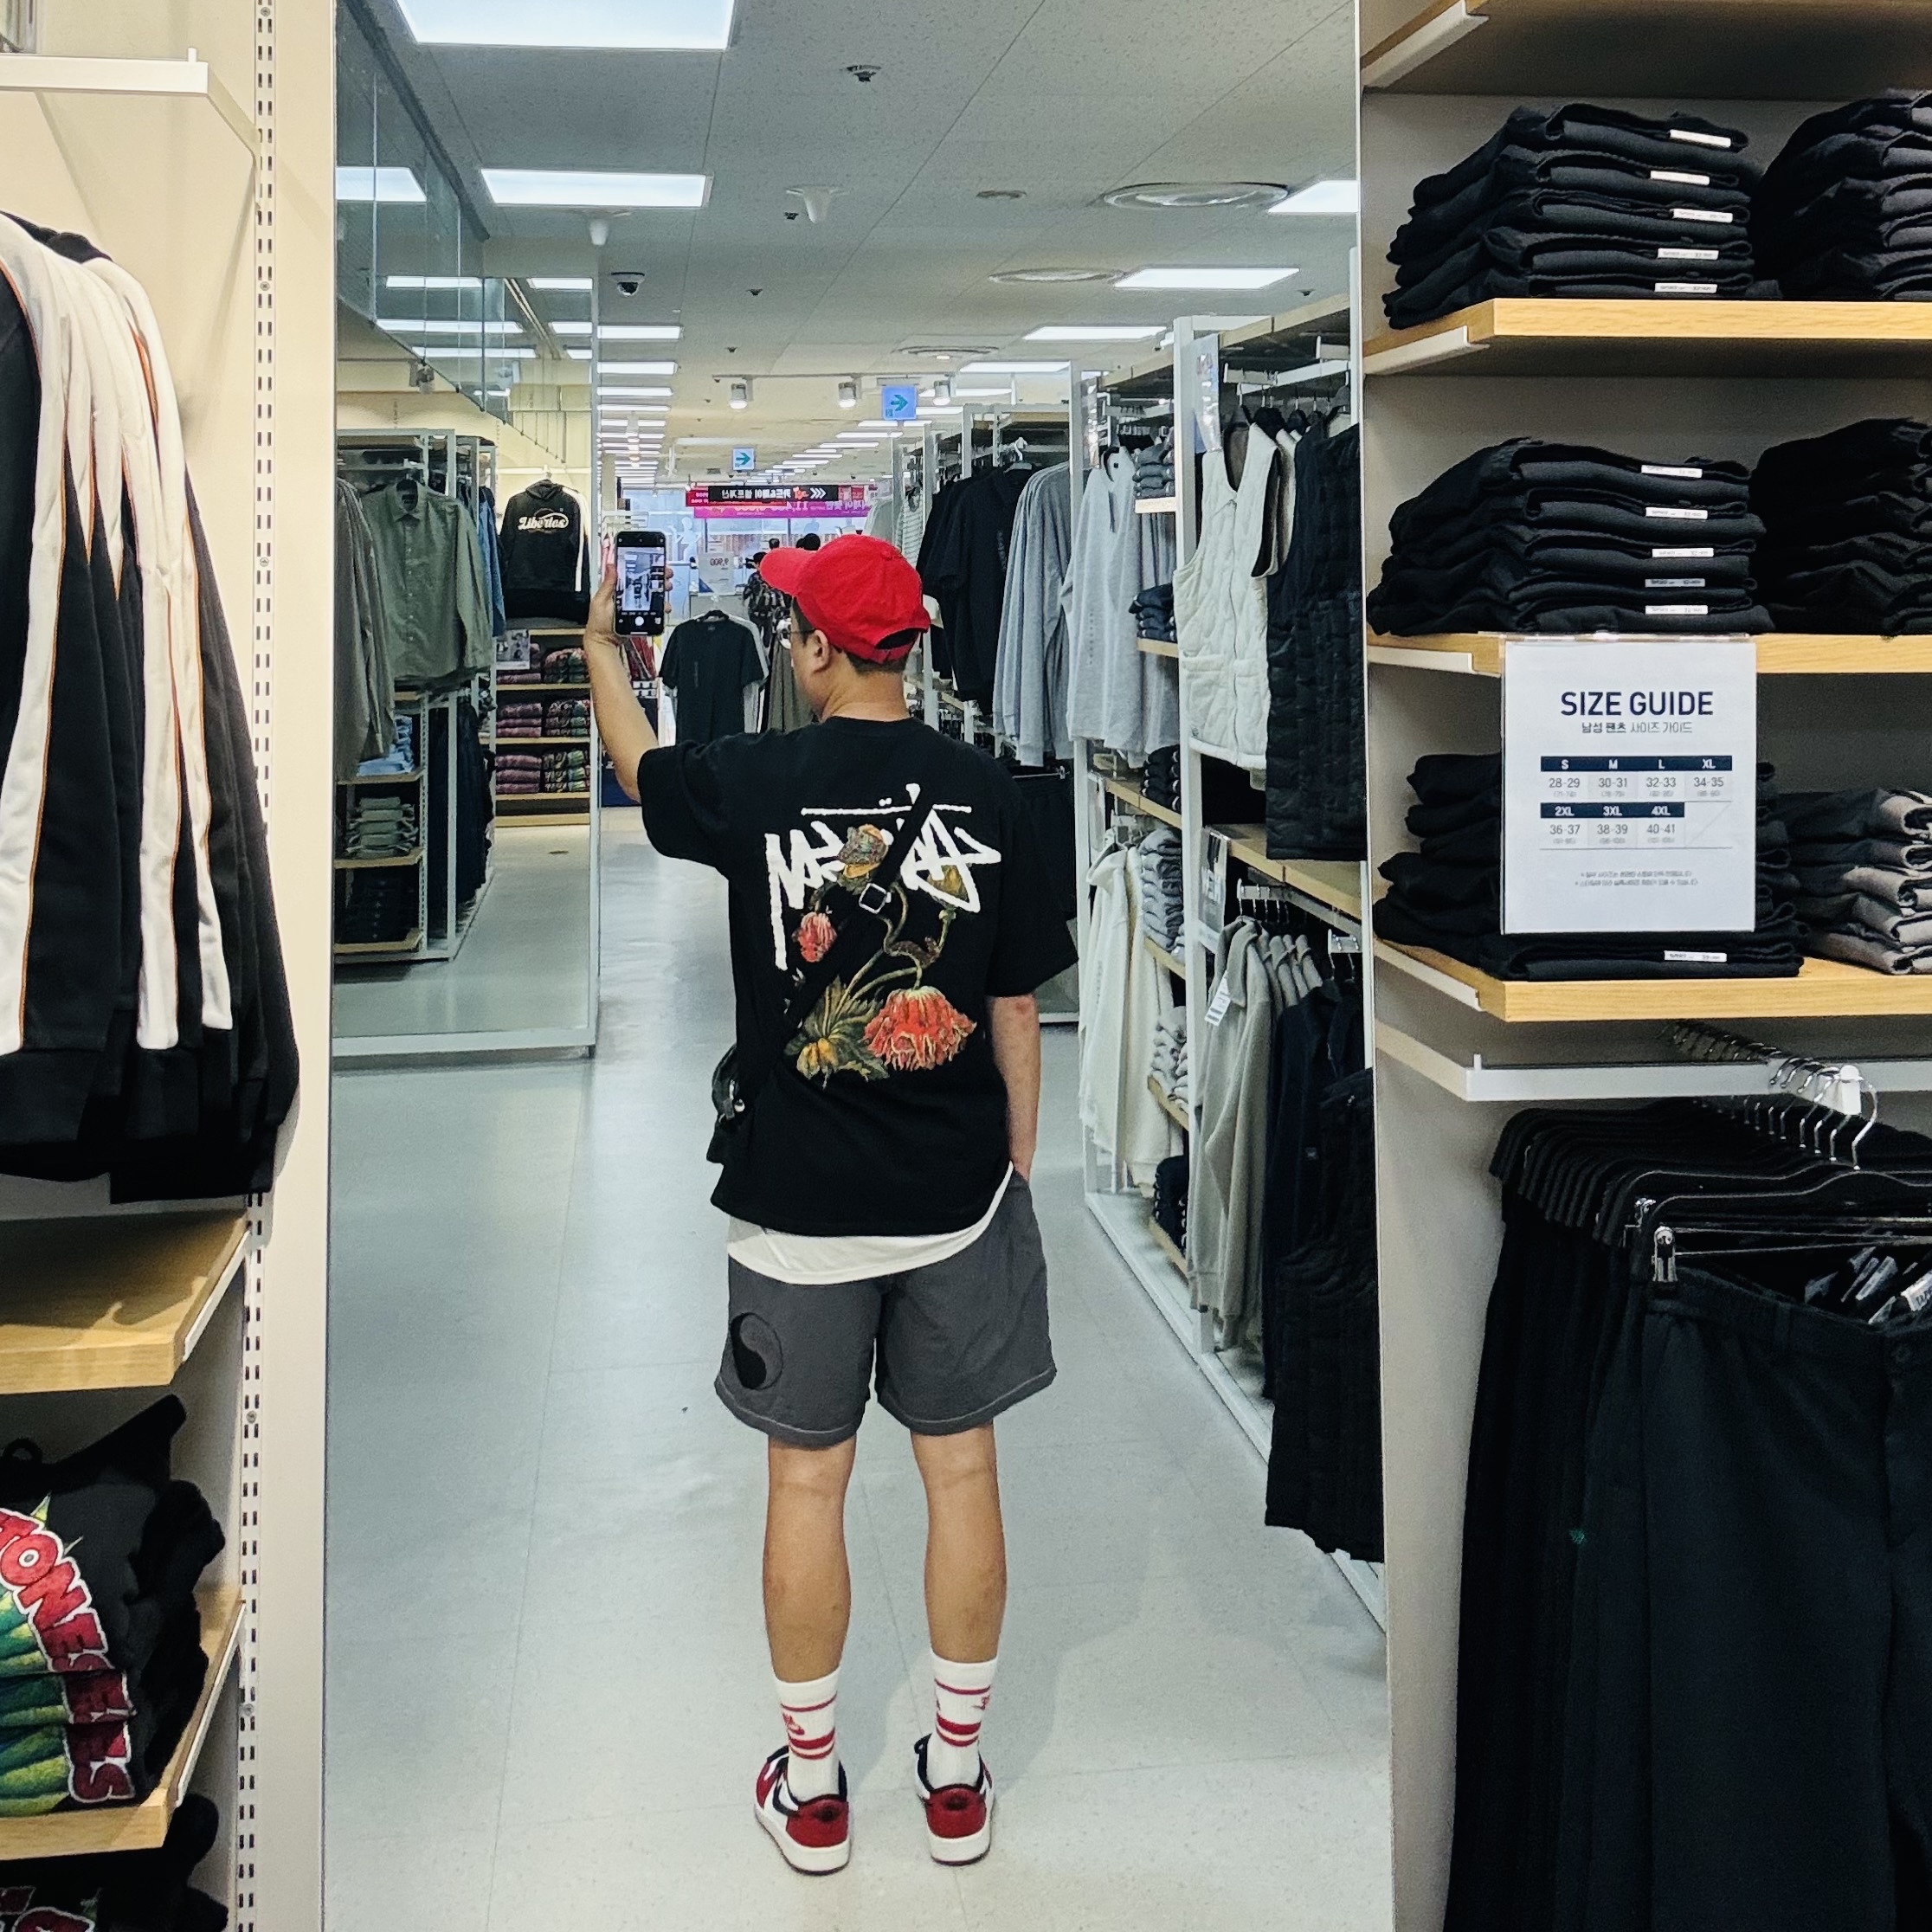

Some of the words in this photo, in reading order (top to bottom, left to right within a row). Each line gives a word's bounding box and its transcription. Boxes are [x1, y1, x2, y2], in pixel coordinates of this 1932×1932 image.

[1561, 692, 1622, 716] SIZE
[1629, 692, 1714, 716] GUIDE
[1581, 722, 1603, 734] 남성
[1630, 722, 1660, 734] 사이즈
[1663, 722, 1693, 734] 가이드
[1561, 759, 1569, 770] S
[1608, 758, 1618, 770] M
[1658, 758, 1665, 770] L
[1702, 758, 1716, 770] XL
[1549, 777, 1581, 789] 28-29
[1598, 777, 1628, 789] 30-31
[1646, 776, 1677, 788] 32-33
[1693, 776, 1724, 788] 34-35
[1555, 806, 1575, 816] 2XL
[1603, 806, 1623, 816] 3XL
[1651, 805, 1671, 816] 4XL
[1549, 823, 1581, 834] 36-37
[1597, 823, 1628, 834] 38-39
[1646, 823, 1676, 834] 40-41
